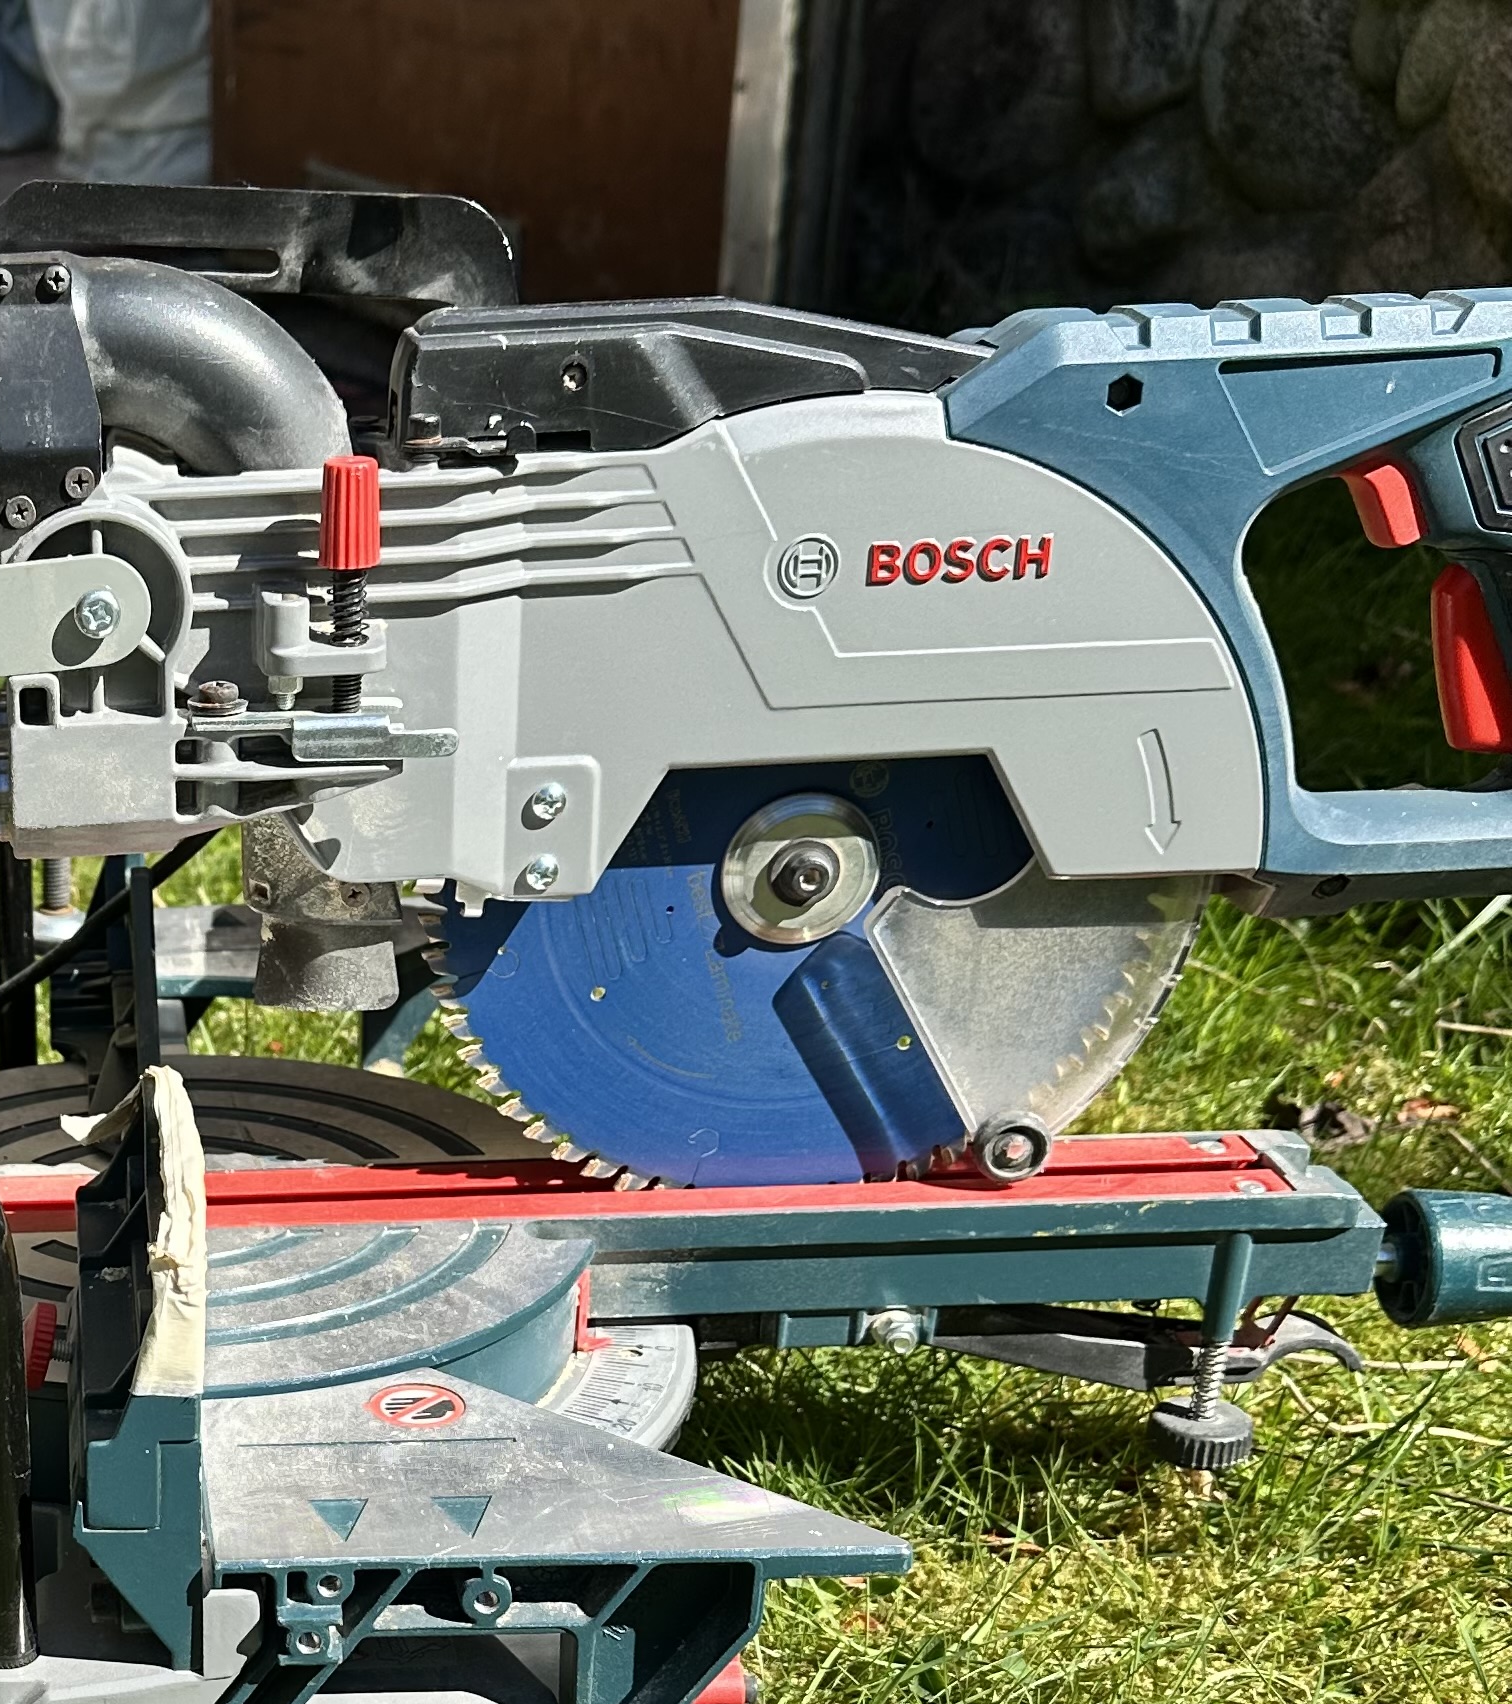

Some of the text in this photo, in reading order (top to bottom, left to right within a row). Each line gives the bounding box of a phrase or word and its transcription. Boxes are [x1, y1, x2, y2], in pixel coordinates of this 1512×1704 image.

[865, 532, 1055, 587] BOSCH
[869, 807, 907, 893] BOSC
[612, 1418, 637, 1432] 20
